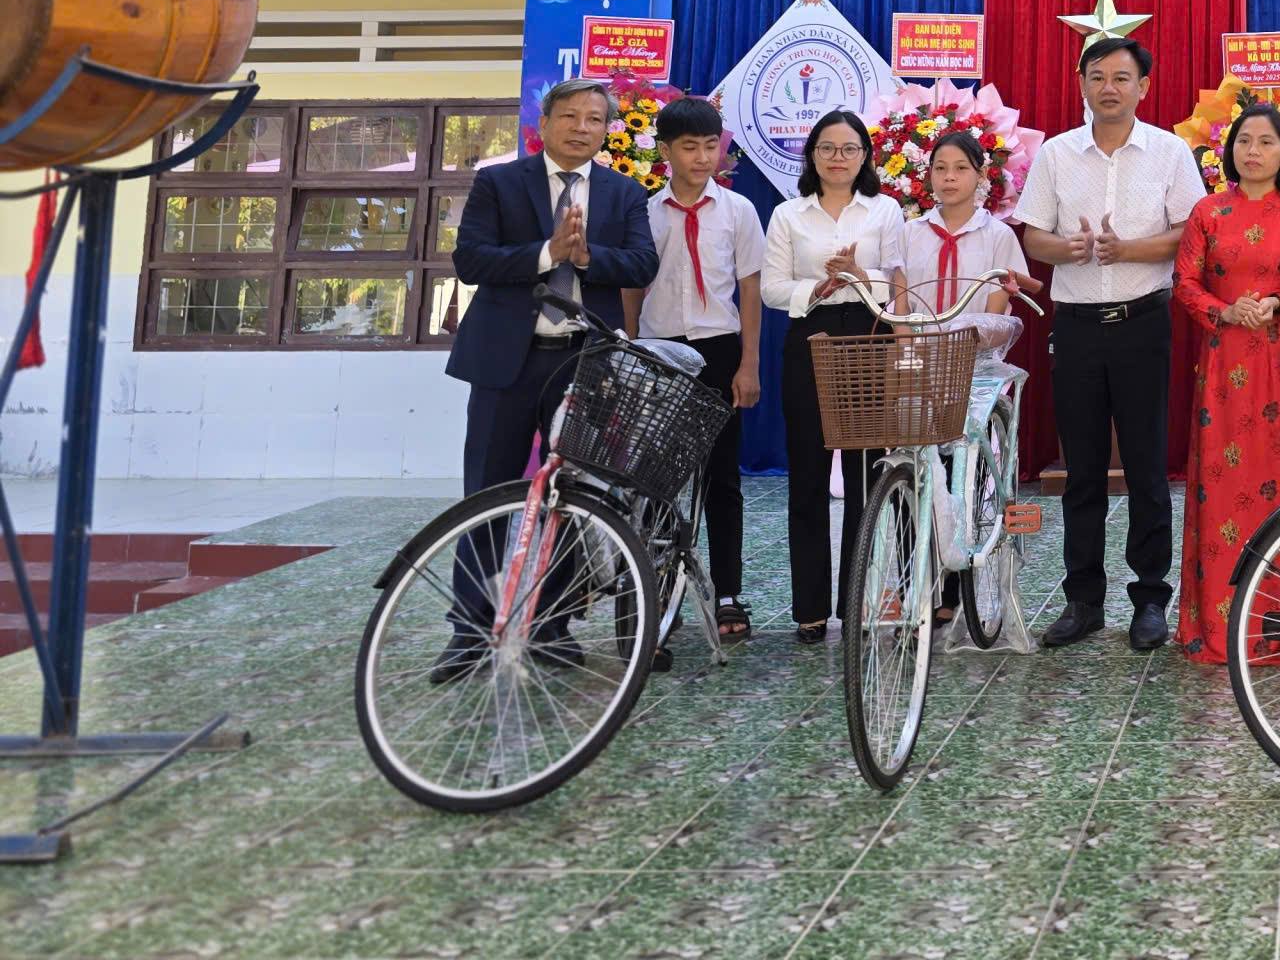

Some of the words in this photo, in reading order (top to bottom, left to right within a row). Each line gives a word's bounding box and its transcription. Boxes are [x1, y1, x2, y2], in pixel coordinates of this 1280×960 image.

[915, 24, 929, 34] BAN
[755, 47, 774, 68] BAN
[775, 30, 806, 48] NHÂN
[810, 27, 833, 39] DÂN
[860, 62, 871, 83] GIA
[787, 48, 820, 61] TRUNG
[795, 109, 820, 120] 1997
[770, 126, 796, 134] PHAN
[756, 145, 787, 170] THÀNH
